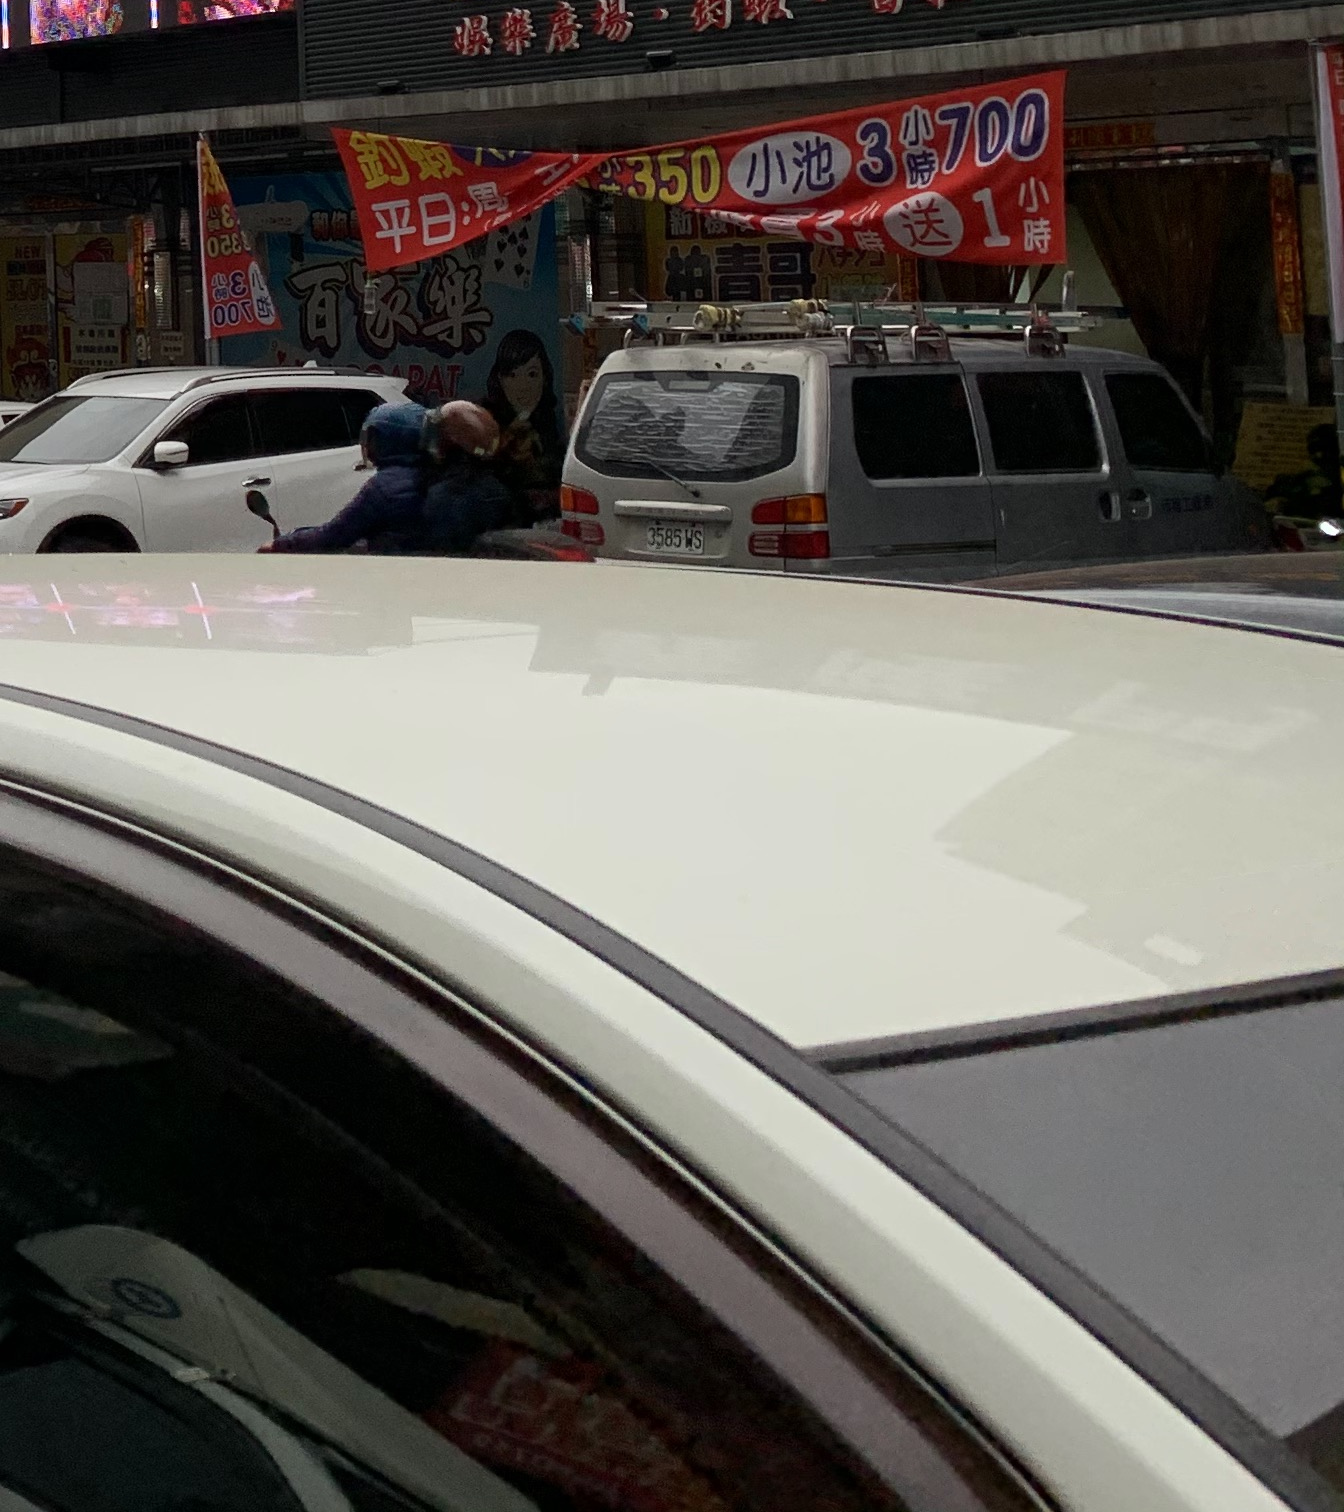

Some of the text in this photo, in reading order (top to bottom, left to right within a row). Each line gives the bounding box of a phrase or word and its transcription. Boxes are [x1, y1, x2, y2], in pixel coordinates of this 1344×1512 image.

[625, 144, 722, 206] 350
[746, 135, 836, 198] 小池
[934, 88, 1050, 176] 700
[900, 195, 954, 249] 送
[1017, 175, 1053, 255] 小時
